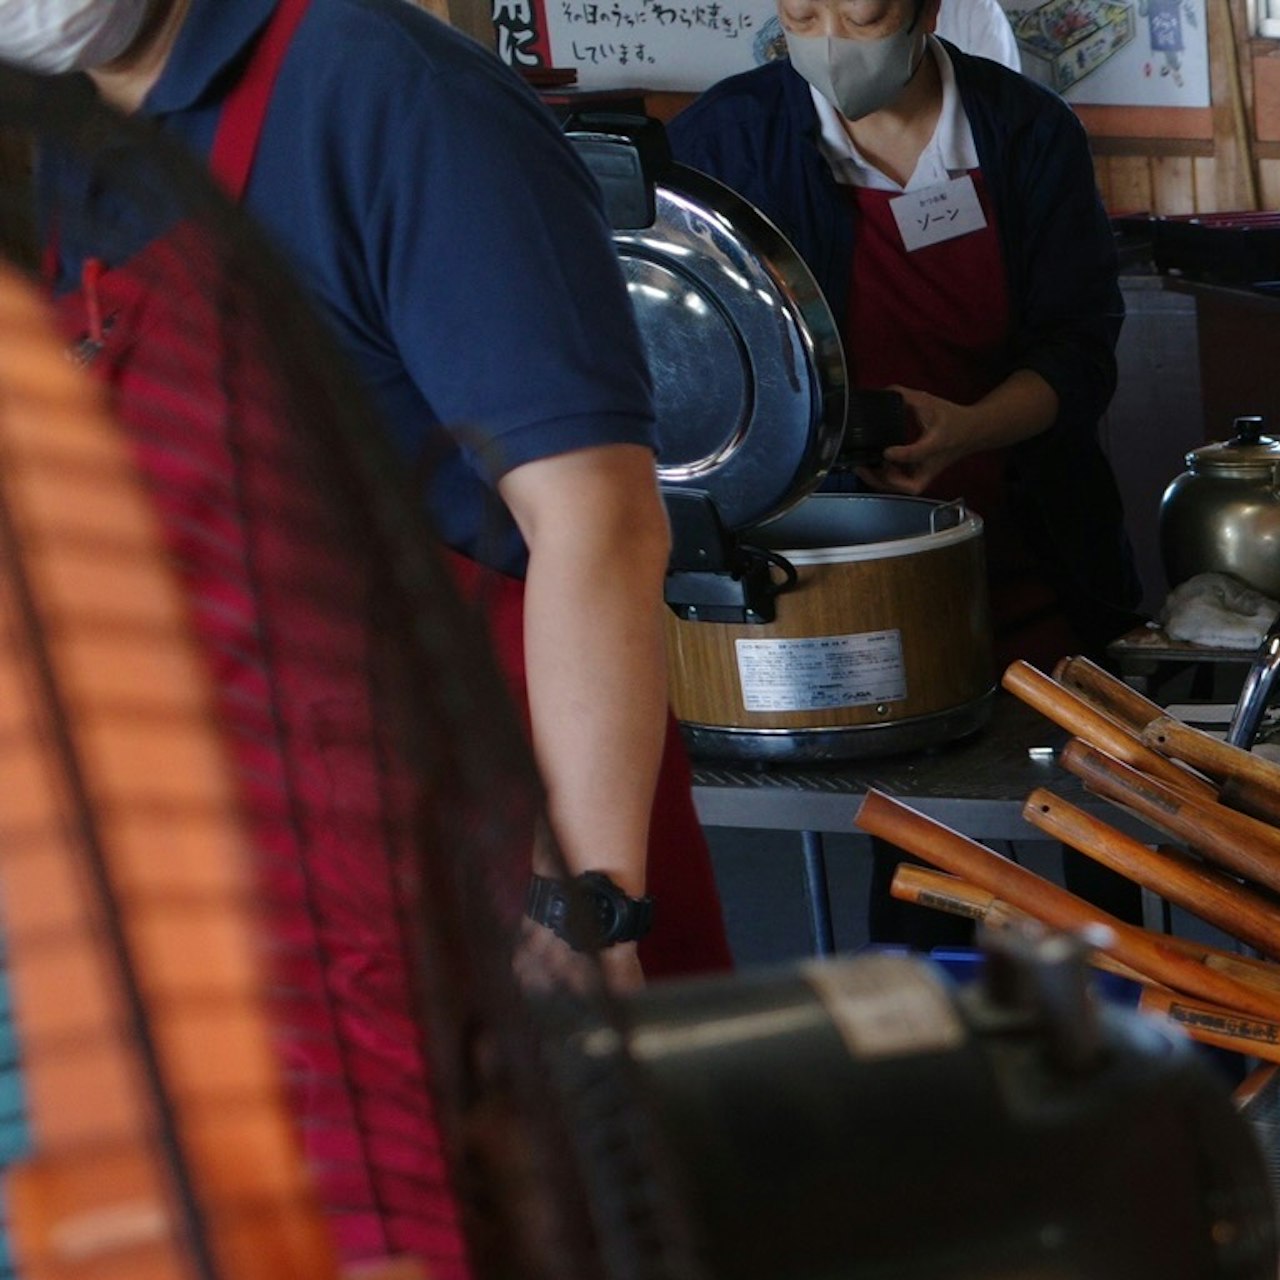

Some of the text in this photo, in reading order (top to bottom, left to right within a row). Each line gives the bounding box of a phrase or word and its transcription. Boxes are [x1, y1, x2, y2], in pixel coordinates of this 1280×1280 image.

[571, 41, 656, 65] しています。
